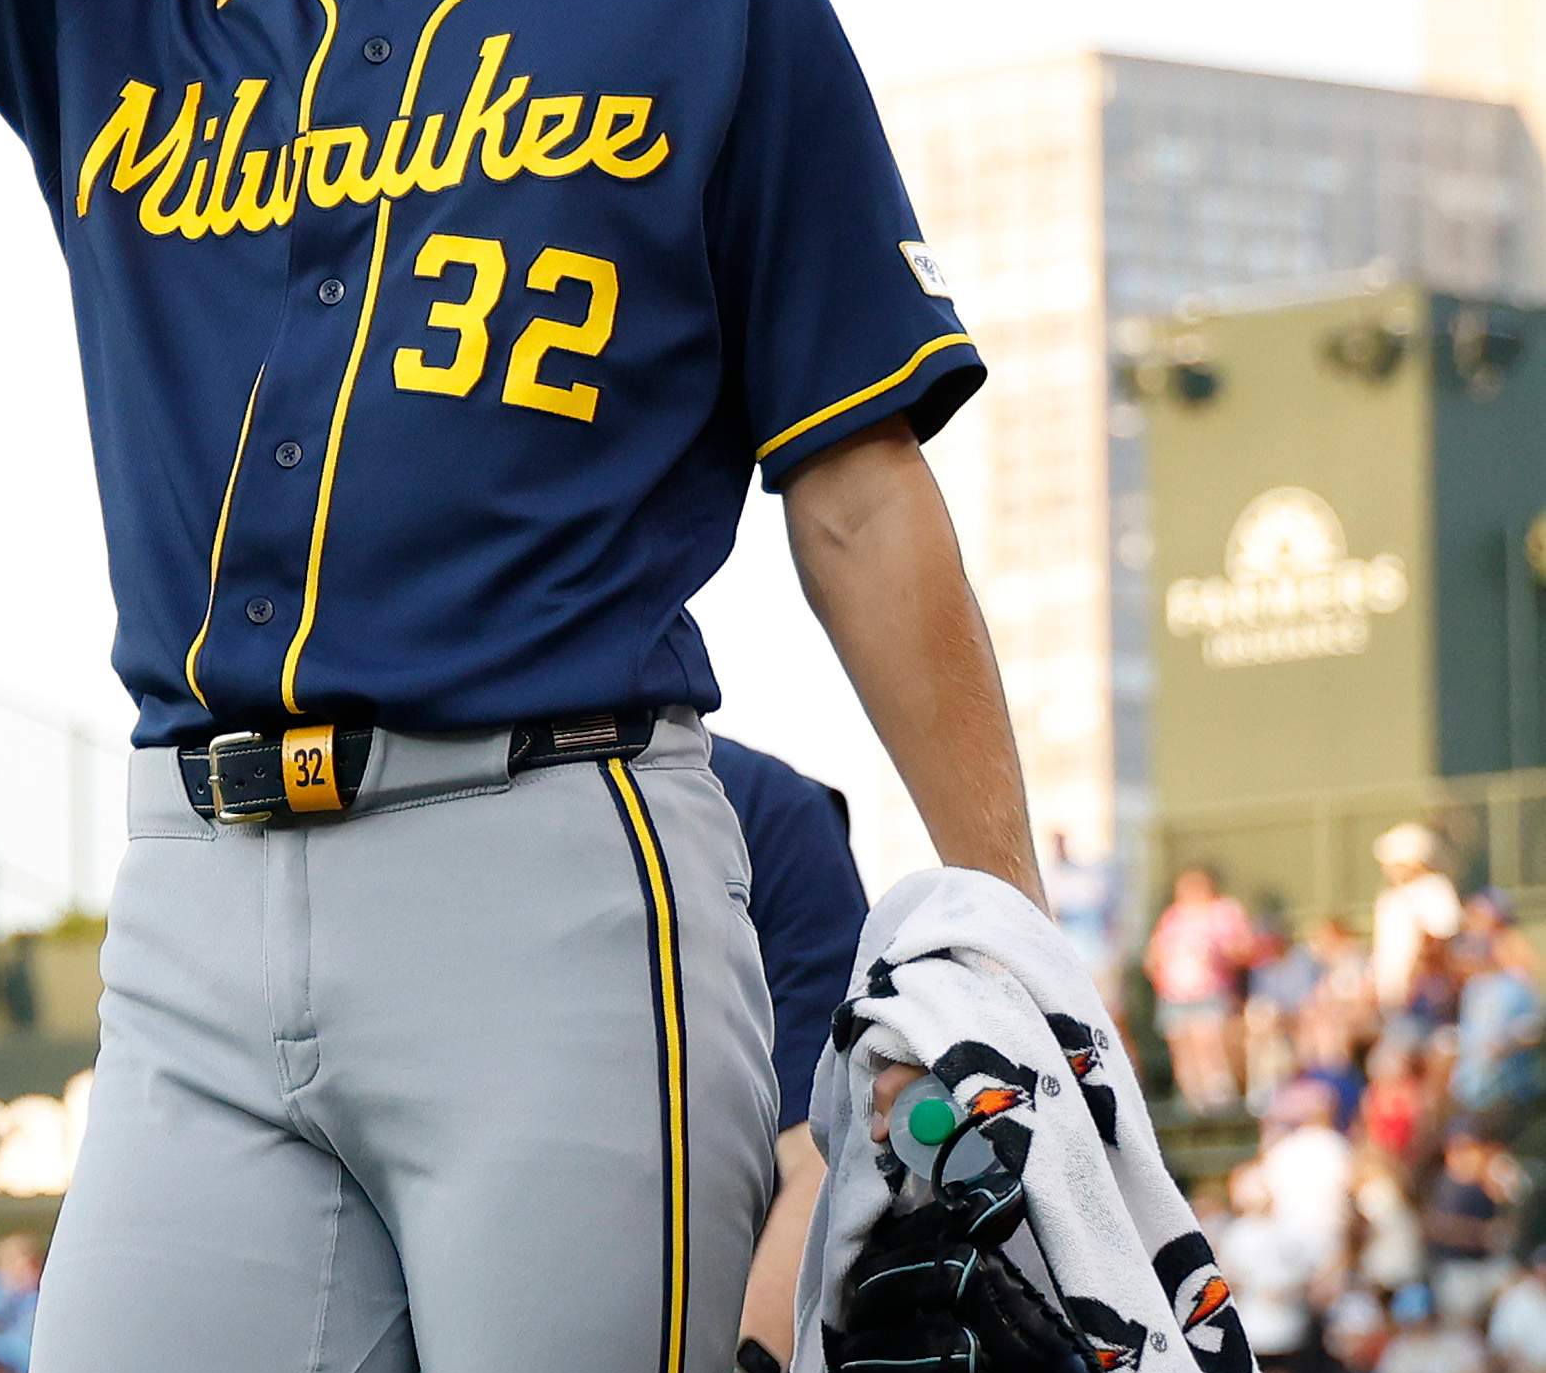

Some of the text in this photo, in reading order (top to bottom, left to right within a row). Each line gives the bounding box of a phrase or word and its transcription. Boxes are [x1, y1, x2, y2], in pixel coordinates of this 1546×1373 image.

[75, 32, 671, 241] Milwaukee
[393, 233, 620, 424] 32
[293, 748, 325, 788] 32
